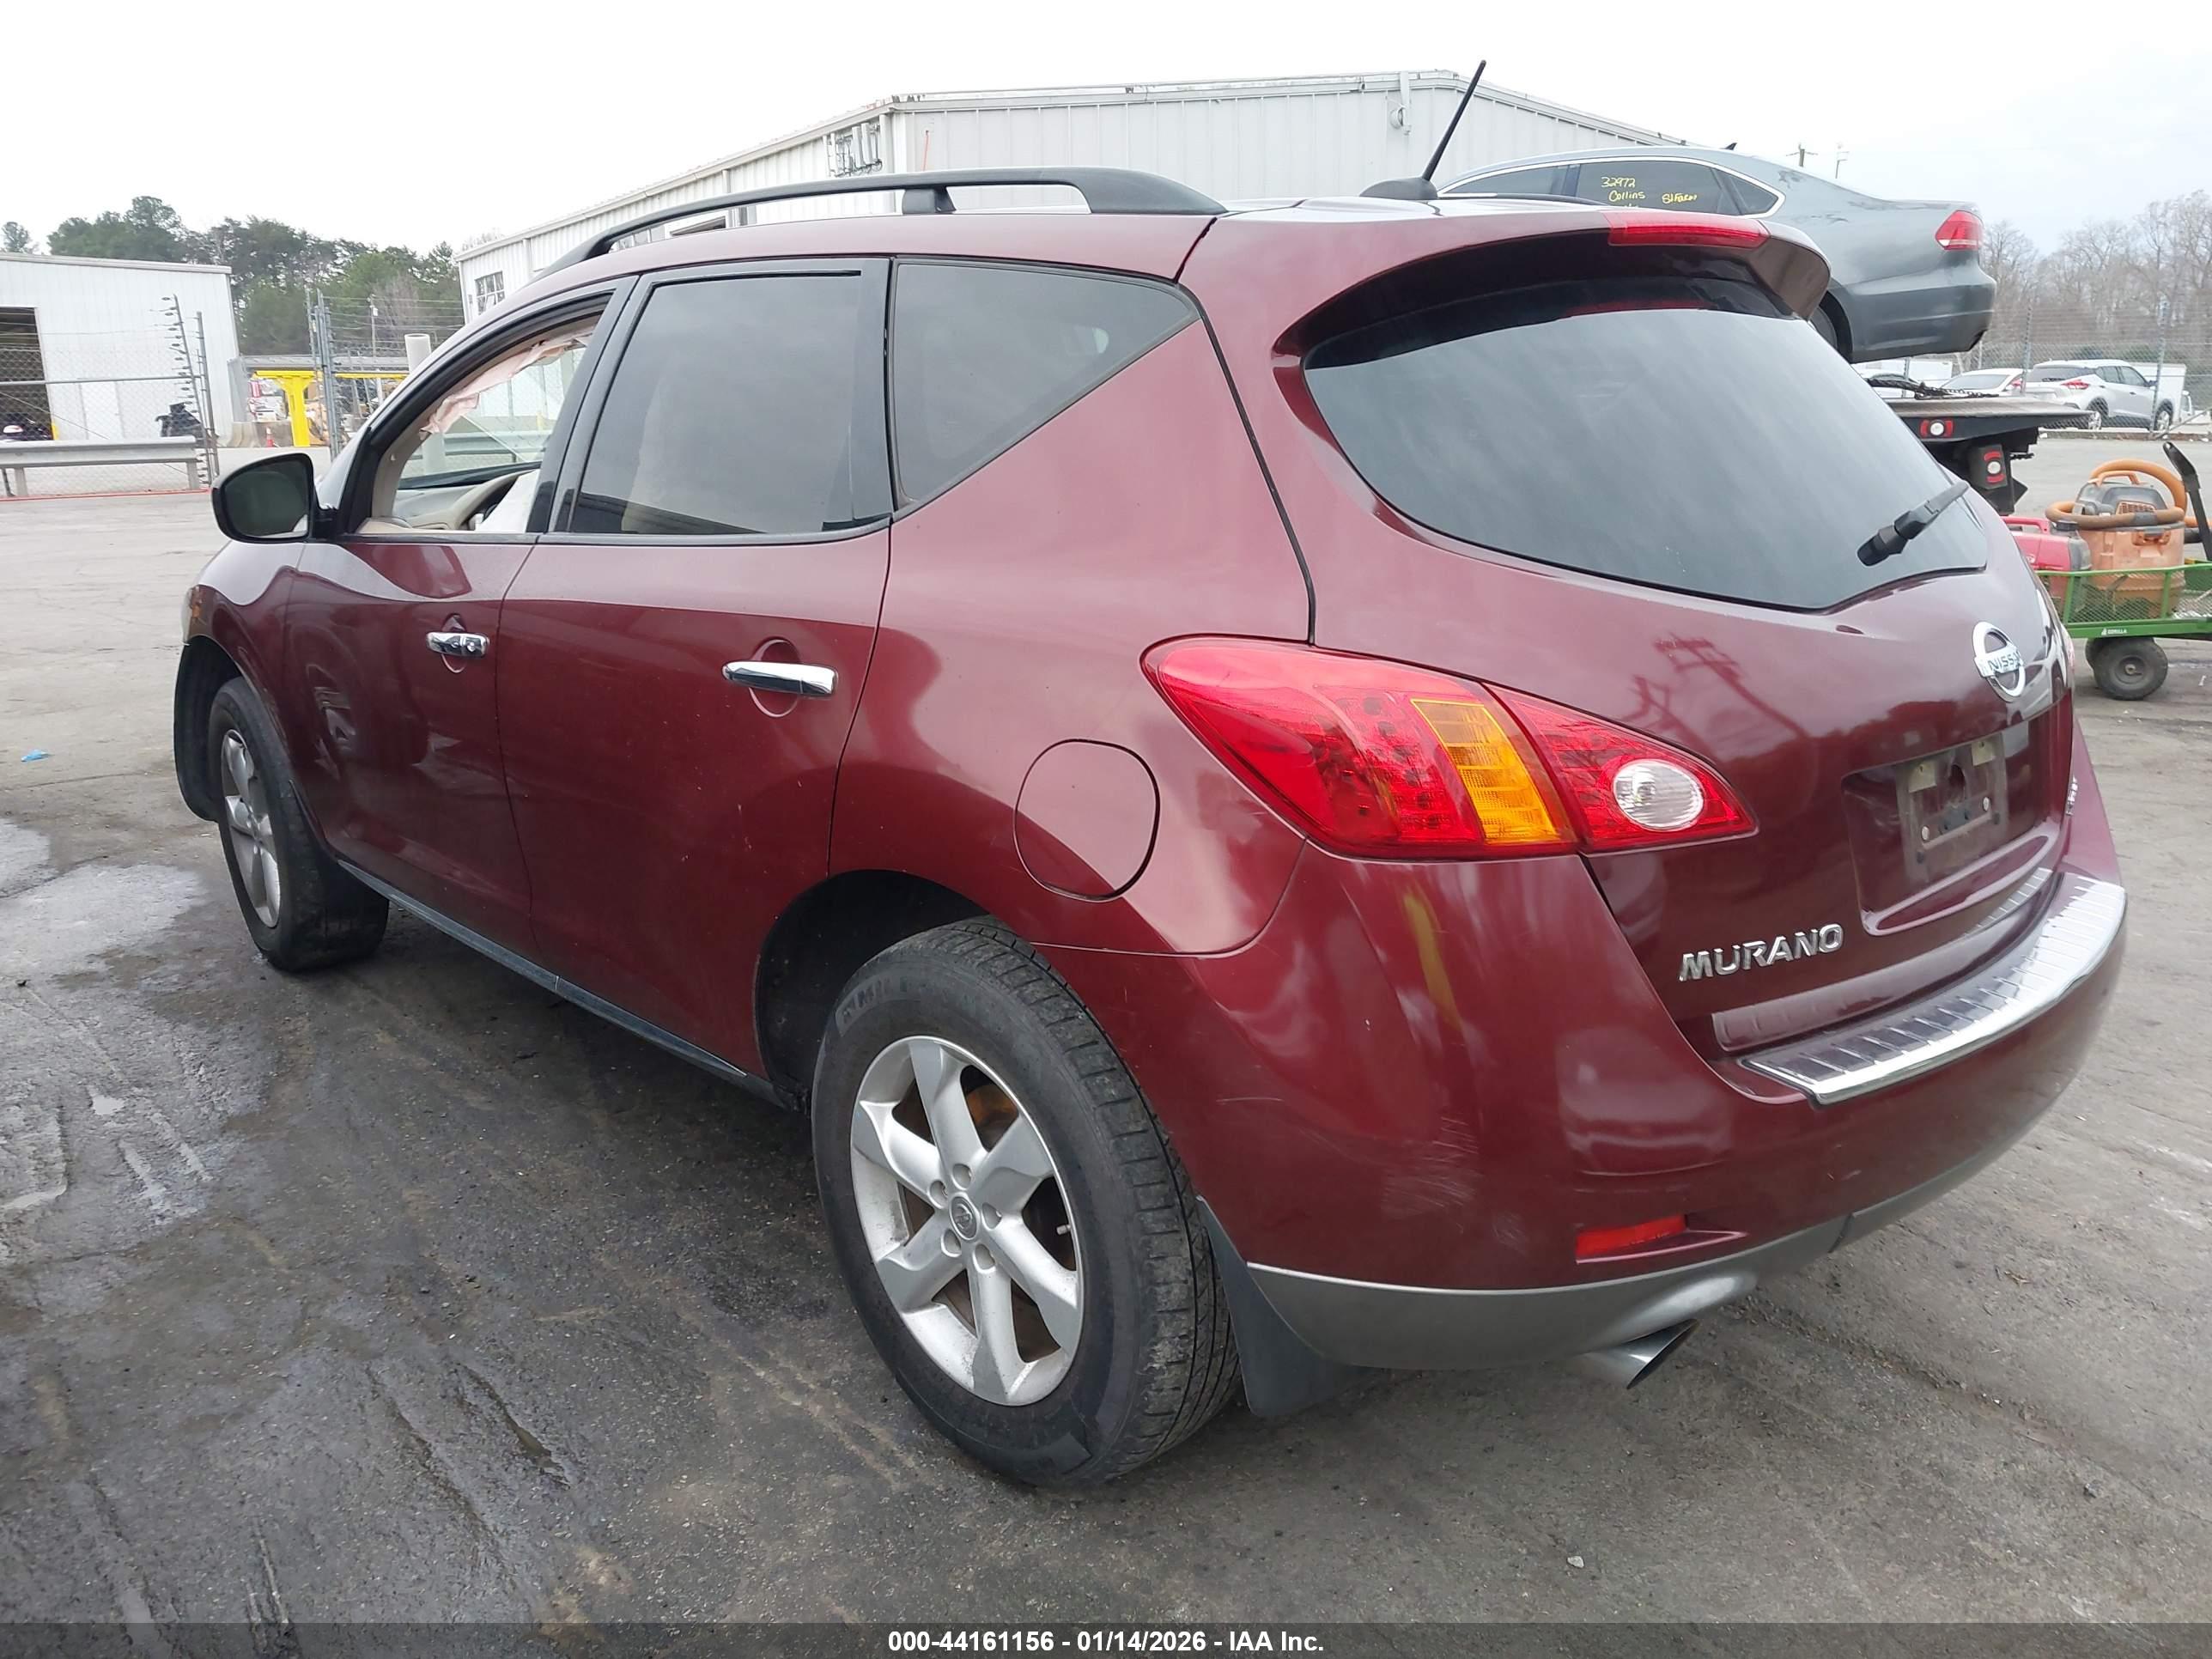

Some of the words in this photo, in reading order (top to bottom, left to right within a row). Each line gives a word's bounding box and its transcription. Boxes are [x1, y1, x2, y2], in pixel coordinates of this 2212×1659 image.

[1601, 177, 1635, 188] 32972
[1608, 190, 1645, 202] Collins
[1679, 923, 1844, 981] MURANO
